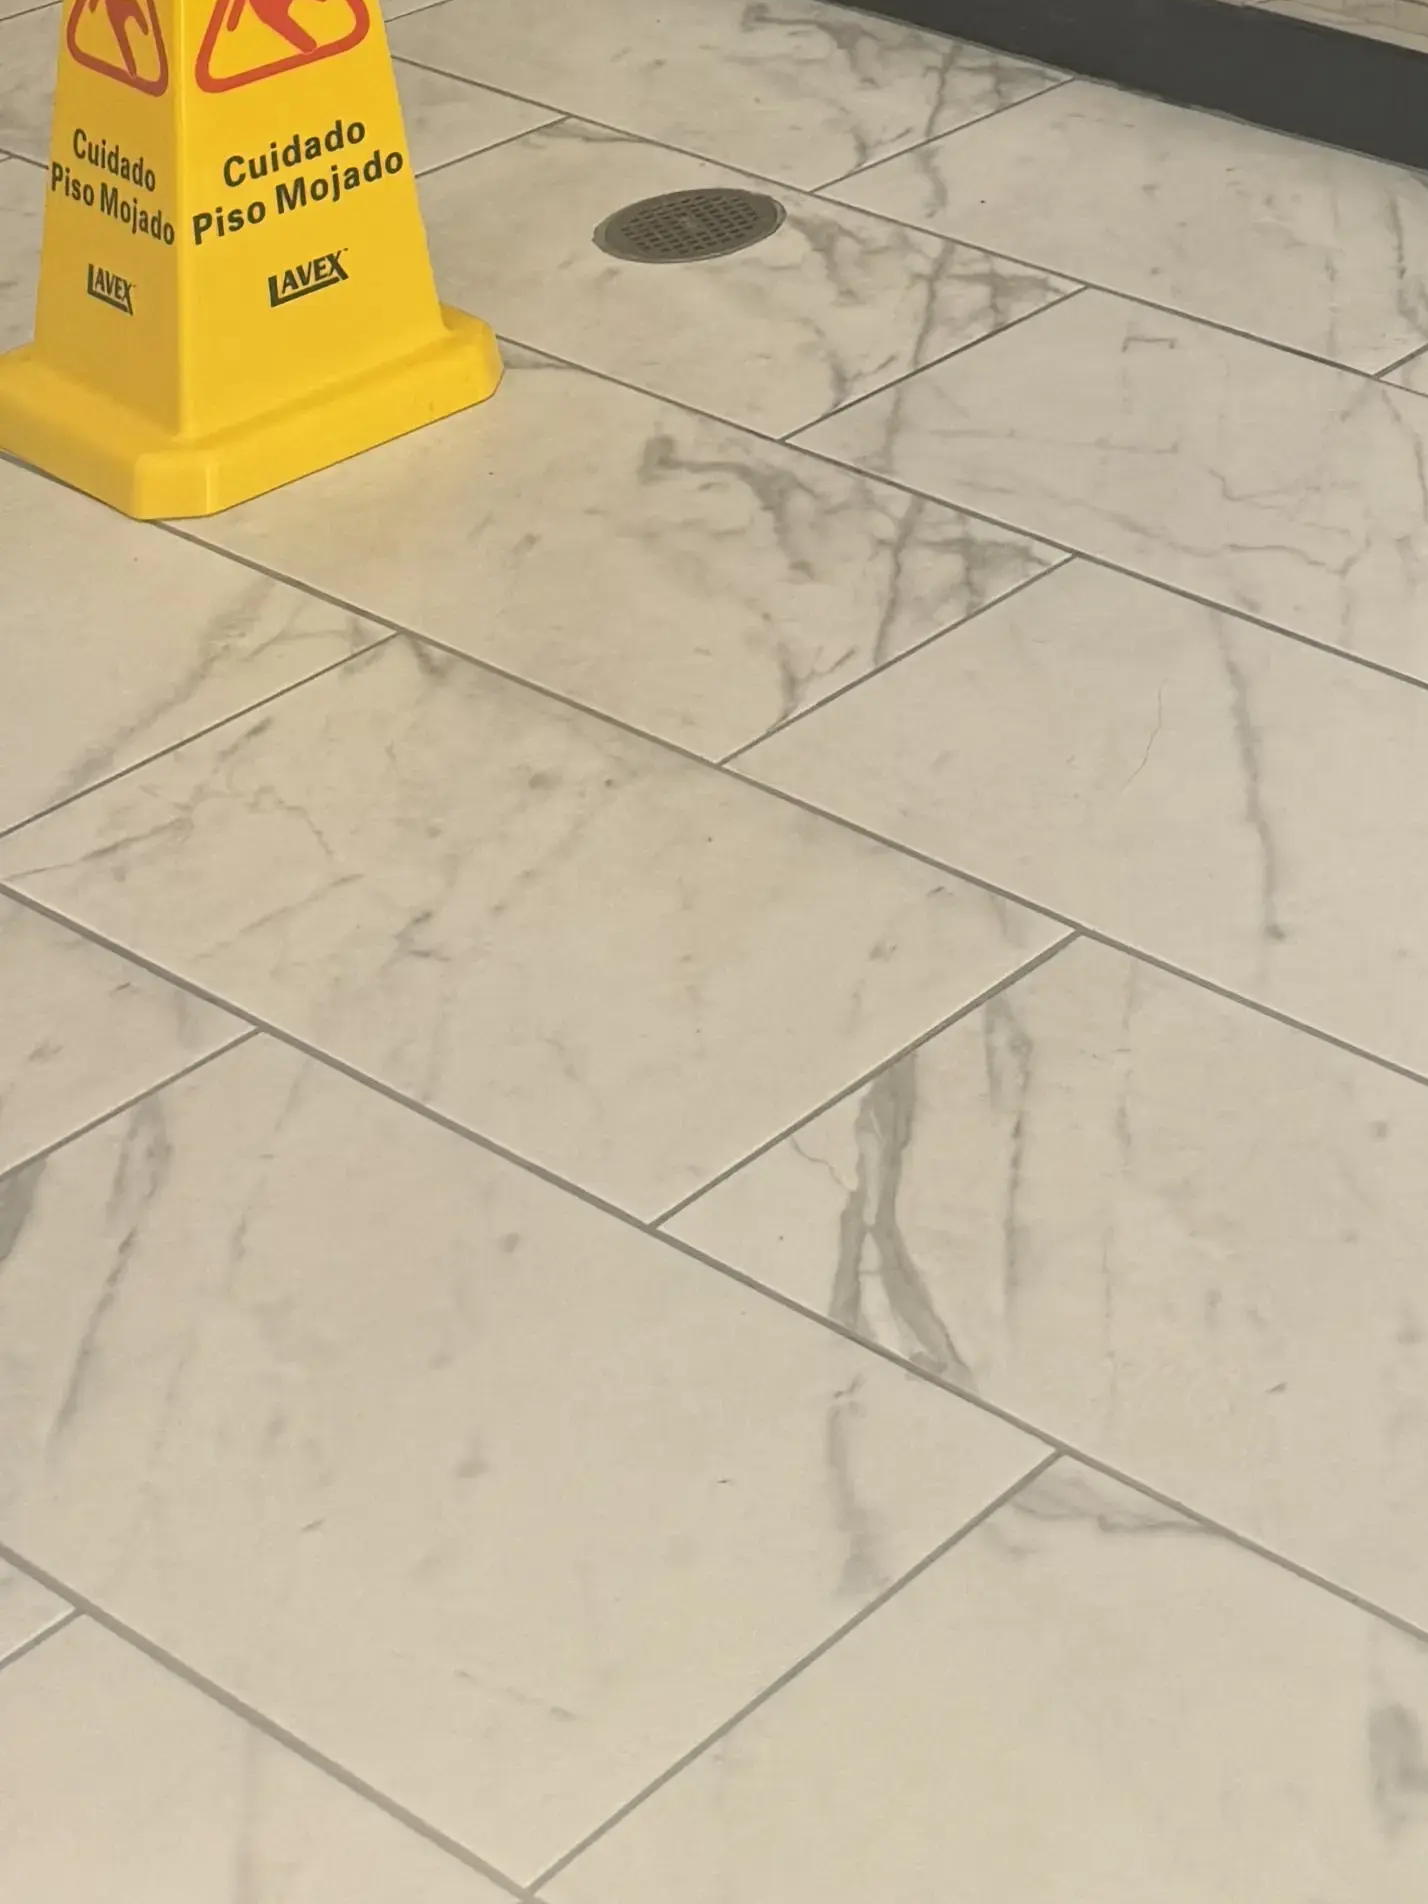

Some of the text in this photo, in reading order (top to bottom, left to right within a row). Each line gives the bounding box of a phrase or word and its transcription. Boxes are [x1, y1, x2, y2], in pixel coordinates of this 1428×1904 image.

[73, 128, 156, 193] Cuidado
[223, 119, 366, 188] Cuidado
[51, 161, 175, 245] Piso Mojado
[192, 149, 404, 245] Piso Mojado
[87, 263, 134, 316] LAVEX
[267, 248, 349, 308] LAVEX
